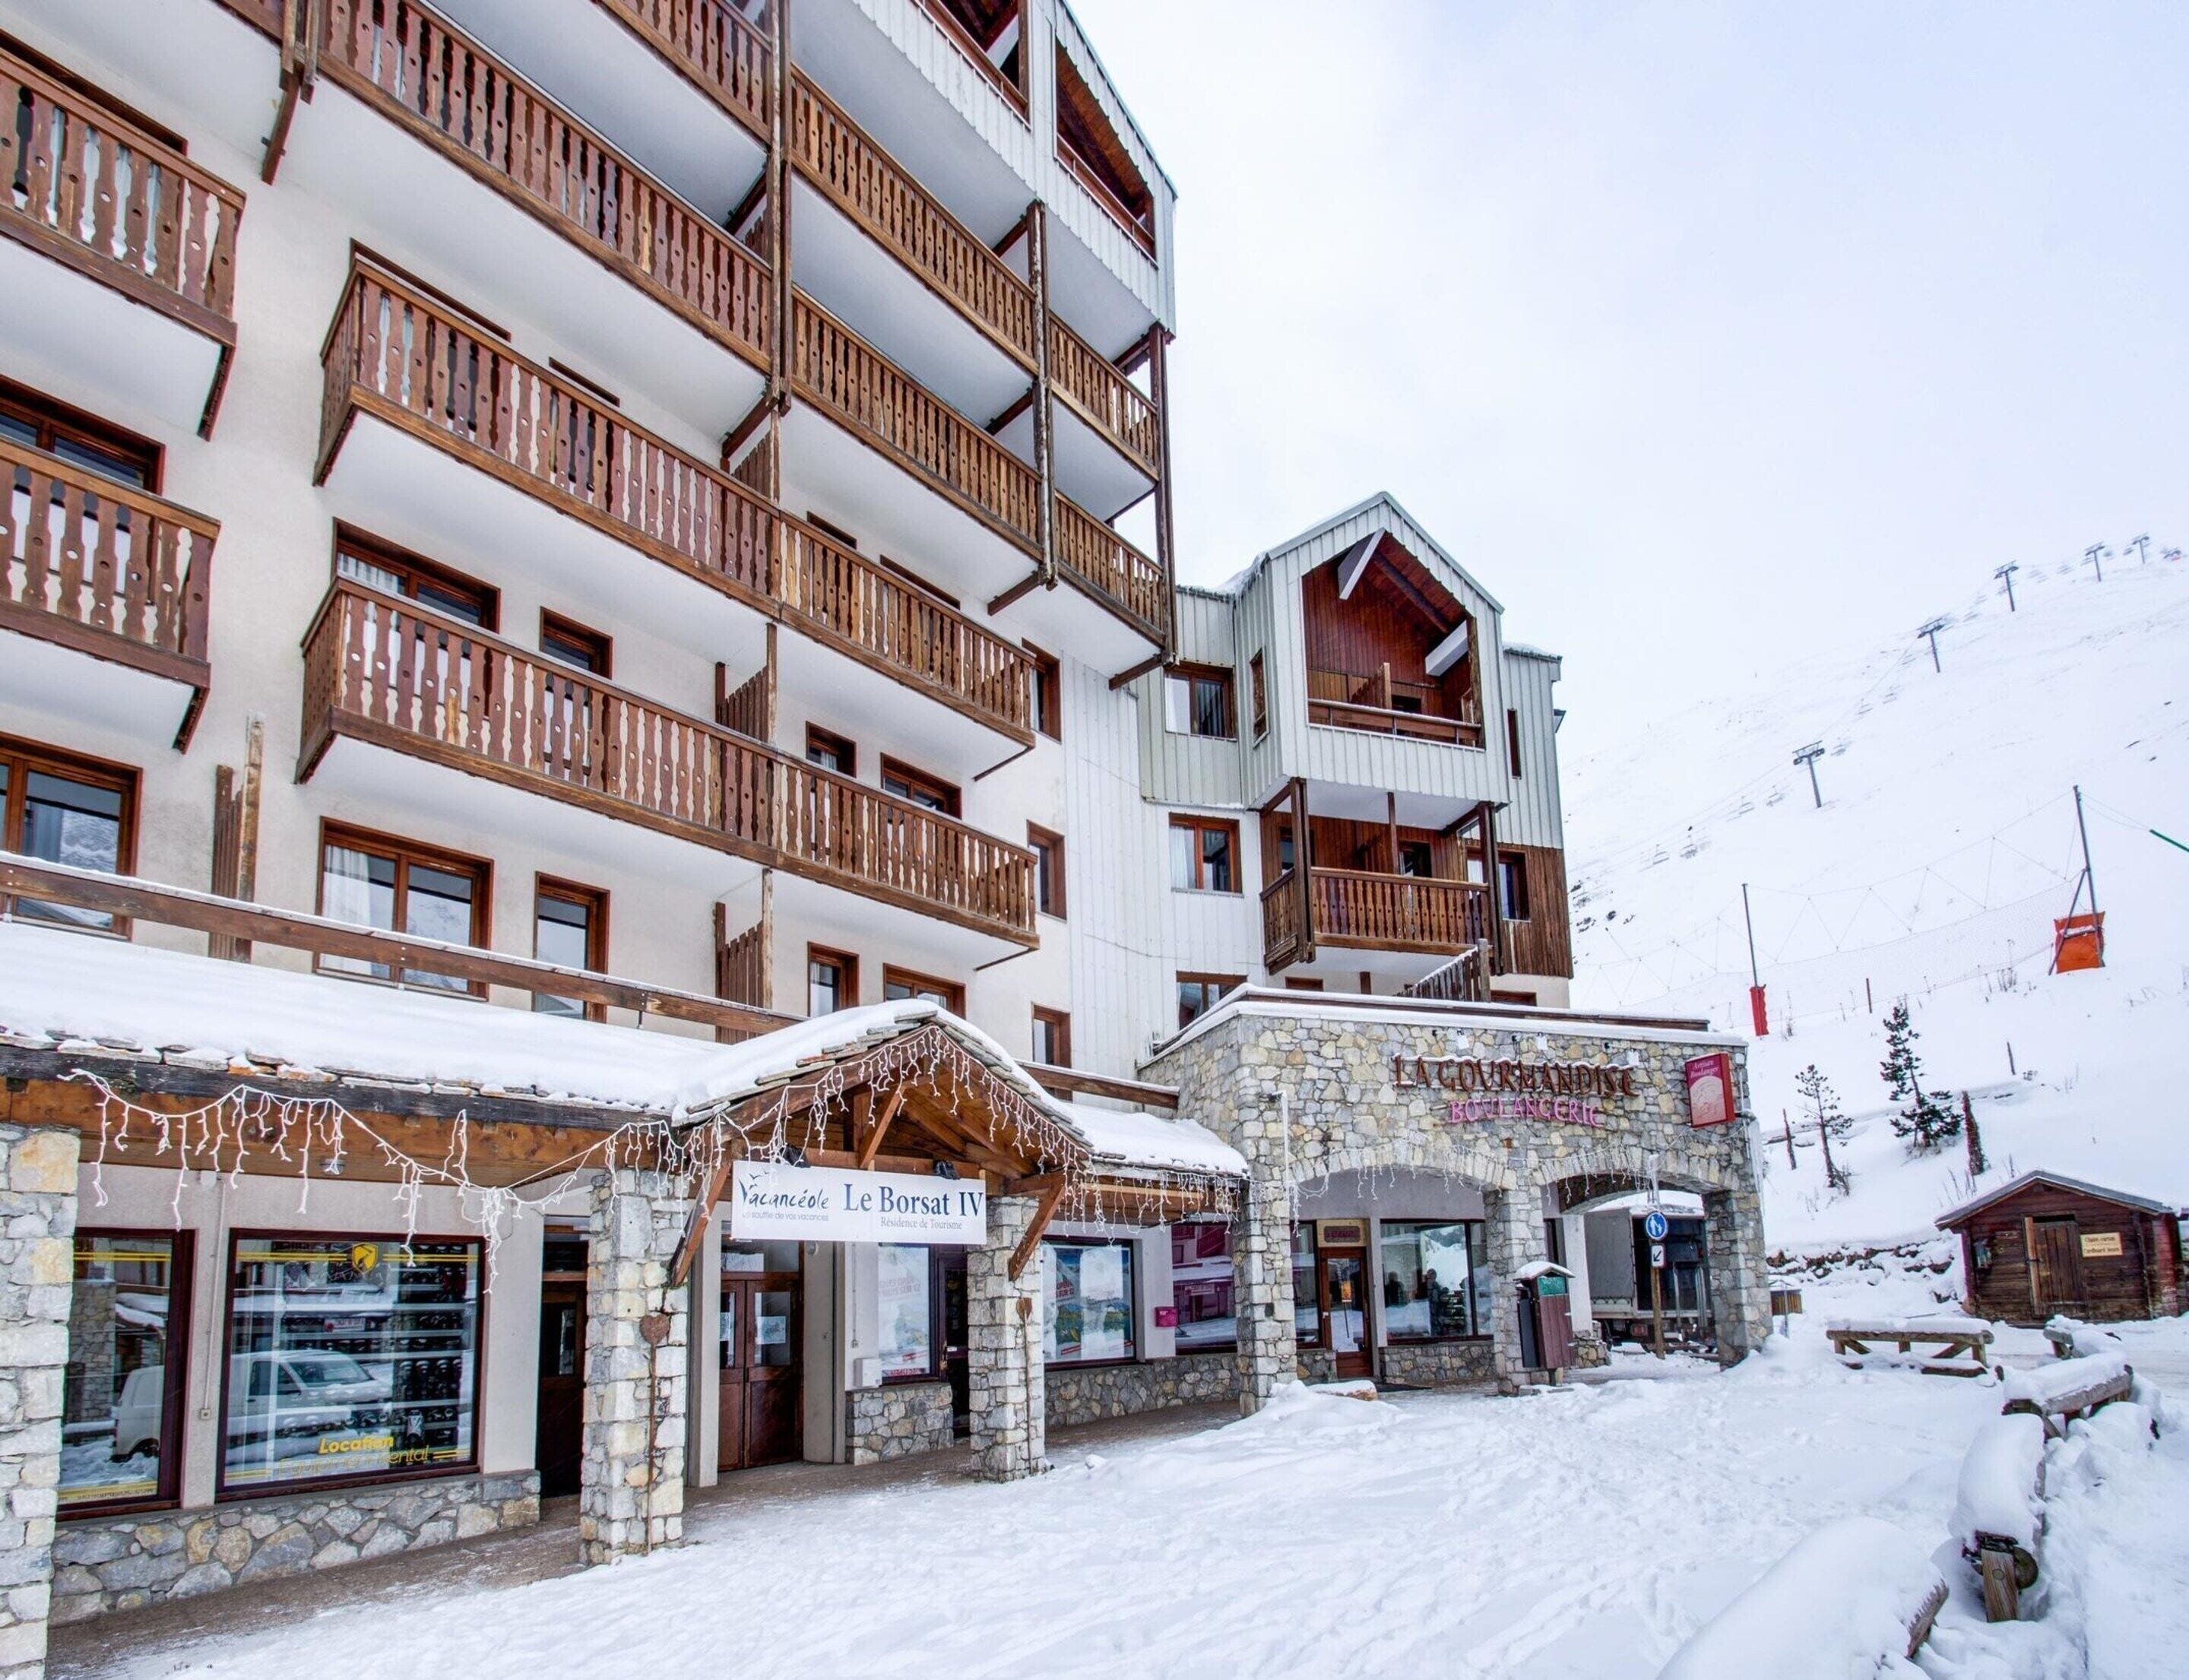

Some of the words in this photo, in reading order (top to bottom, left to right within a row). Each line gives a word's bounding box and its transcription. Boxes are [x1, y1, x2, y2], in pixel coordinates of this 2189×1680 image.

[1394, 1055, 1432, 1088] LA
[1438, 1058, 1640, 1097] GOURMANDISE
[1451, 1097, 1605, 1128] BOULANGERIE
[739, 1178, 829, 1209] Vacancéole
[844, 1184, 872, 1212] Le
[879, 1186, 950, 1216] Borsat
[959, 1191, 984, 1216] IV
[881, 1217, 917, 1228] Résidence
[919, 1219, 928, 1228] de
[930, 1219, 961, 1230] Tourisme
[319, 1436, 394, 1454] Location
